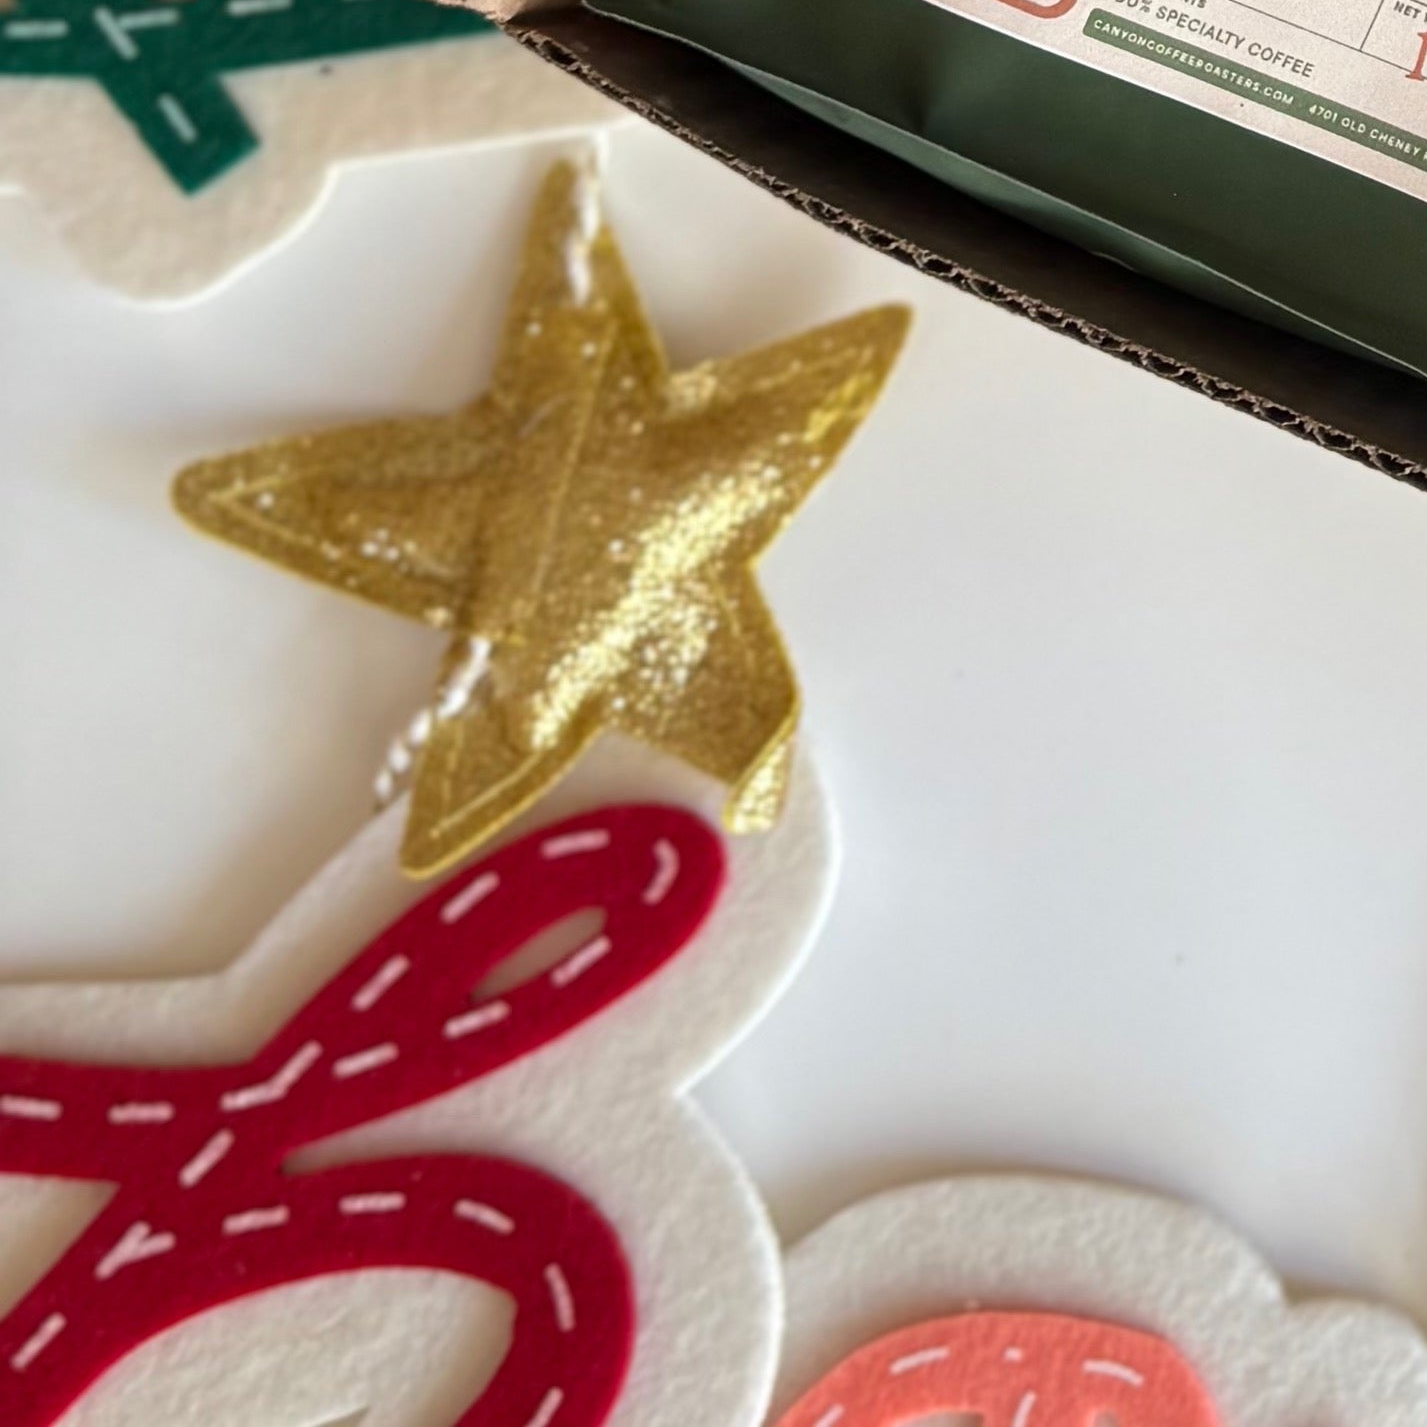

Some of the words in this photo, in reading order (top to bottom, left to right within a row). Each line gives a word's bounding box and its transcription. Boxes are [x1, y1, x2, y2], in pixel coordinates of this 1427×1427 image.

[1155, 6, 1246, 49] SPECIALTY
[1247, 43, 1316, 78] COFFEE
[1393, 1, 1421, 19] NET
[1093, 19, 1294, 105] CANYONCOFFEEROASTERS.COM
[1308, 103, 1338, 123] 4701
[1340, 117, 1367, 134] OLD
[1369, 128, 1422, 157] CHENEY
